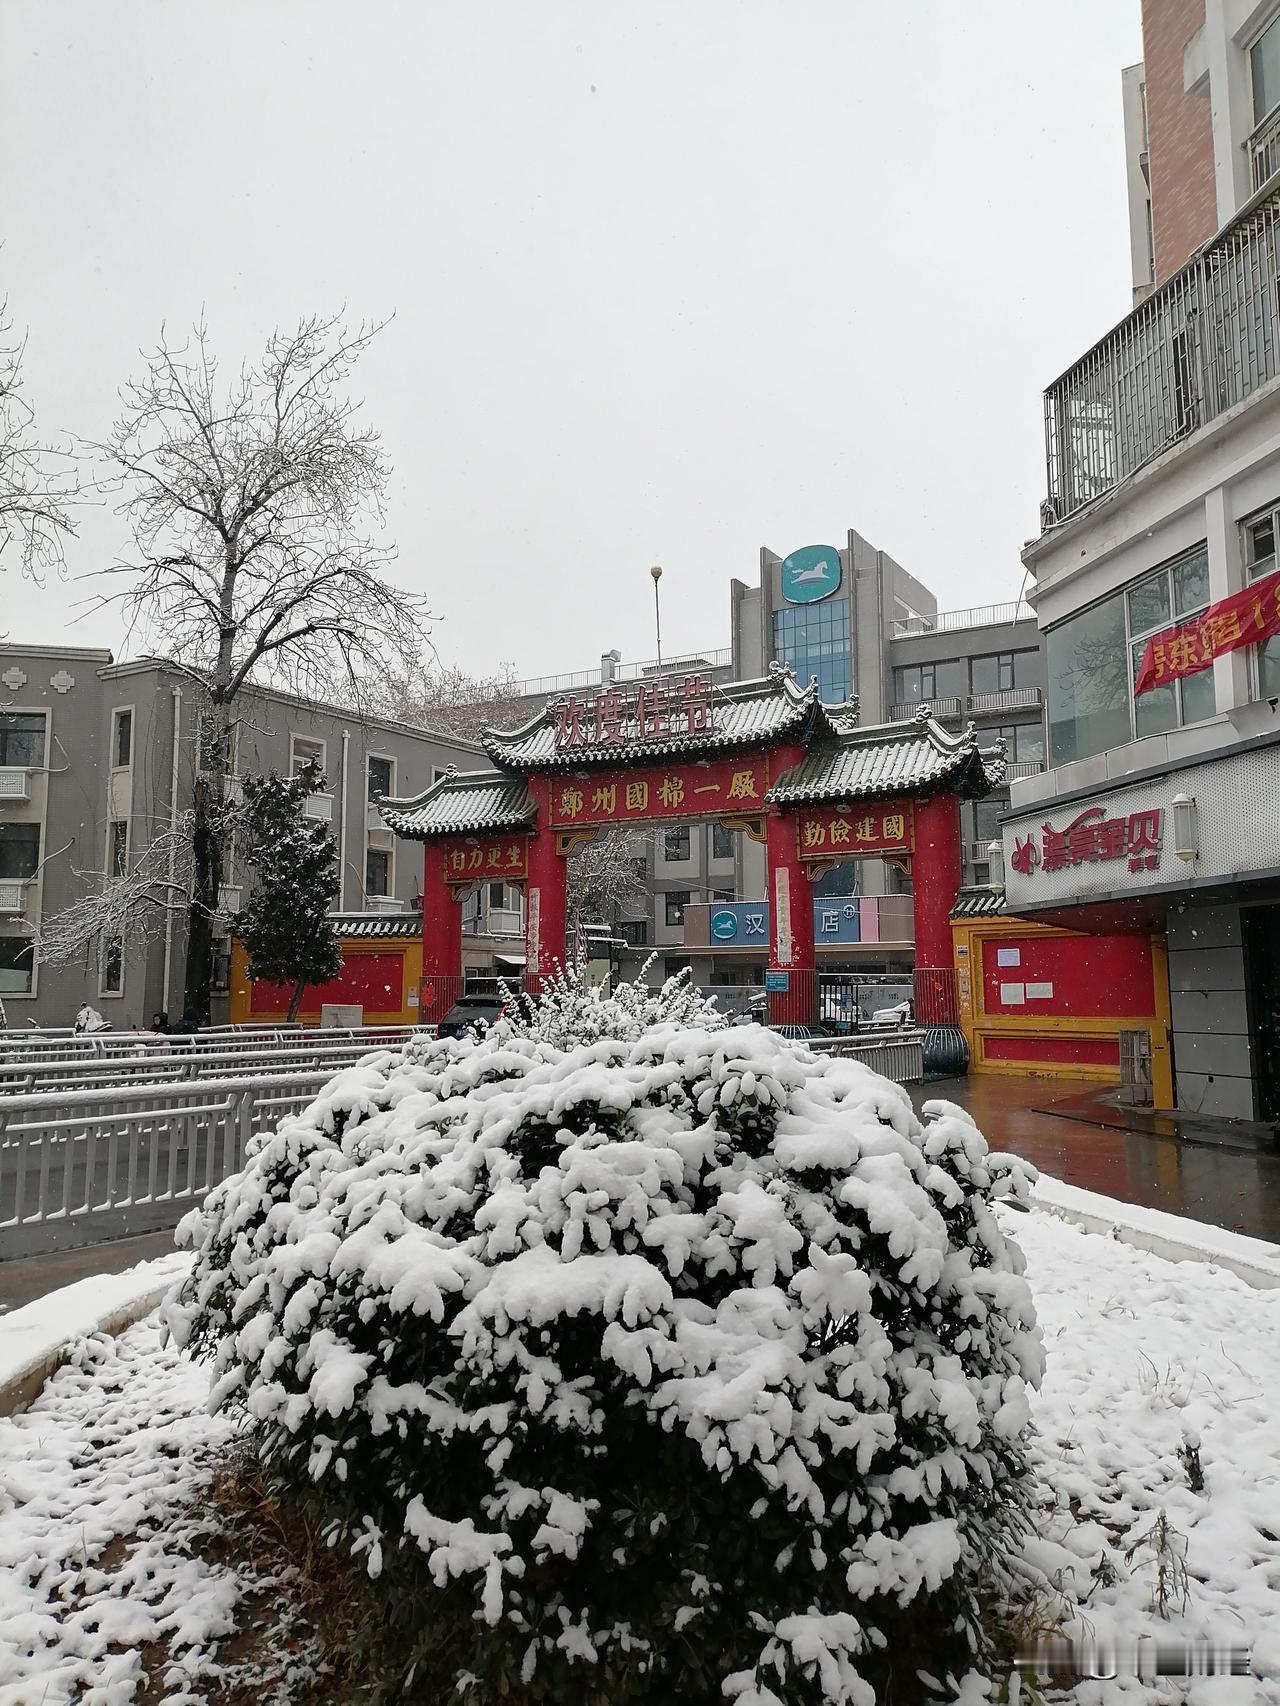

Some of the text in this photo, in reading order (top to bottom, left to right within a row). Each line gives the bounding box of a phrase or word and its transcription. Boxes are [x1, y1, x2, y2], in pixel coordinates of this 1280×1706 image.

[555, 674, 709, 749] 欢度佳节
[450, 845, 523, 871] 自力更生
